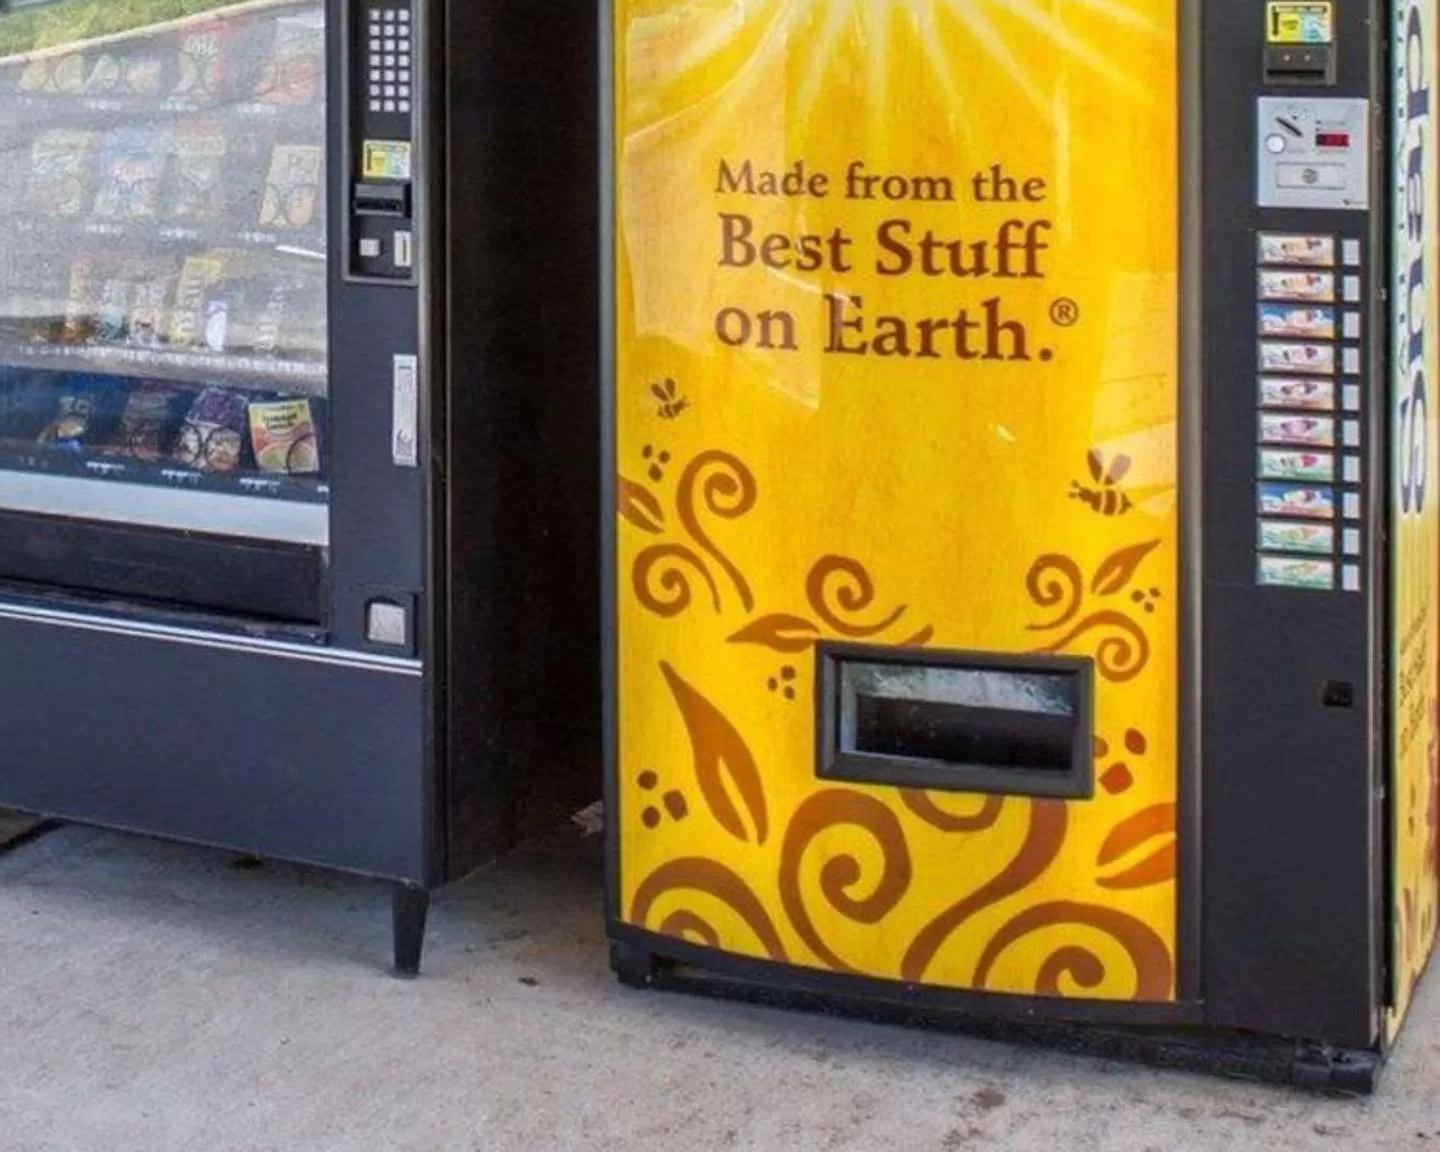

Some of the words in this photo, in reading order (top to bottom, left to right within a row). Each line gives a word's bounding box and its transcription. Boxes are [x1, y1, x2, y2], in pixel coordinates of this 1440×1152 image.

[715, 157, 829, 197] Made
[844, 161, 955, 201] from
[971, 163, 1047, 202] the
[717, 211, 852, 273] Best
[875, 218, 1052, 278] Stuff
[714, 304, 798, 350] on
